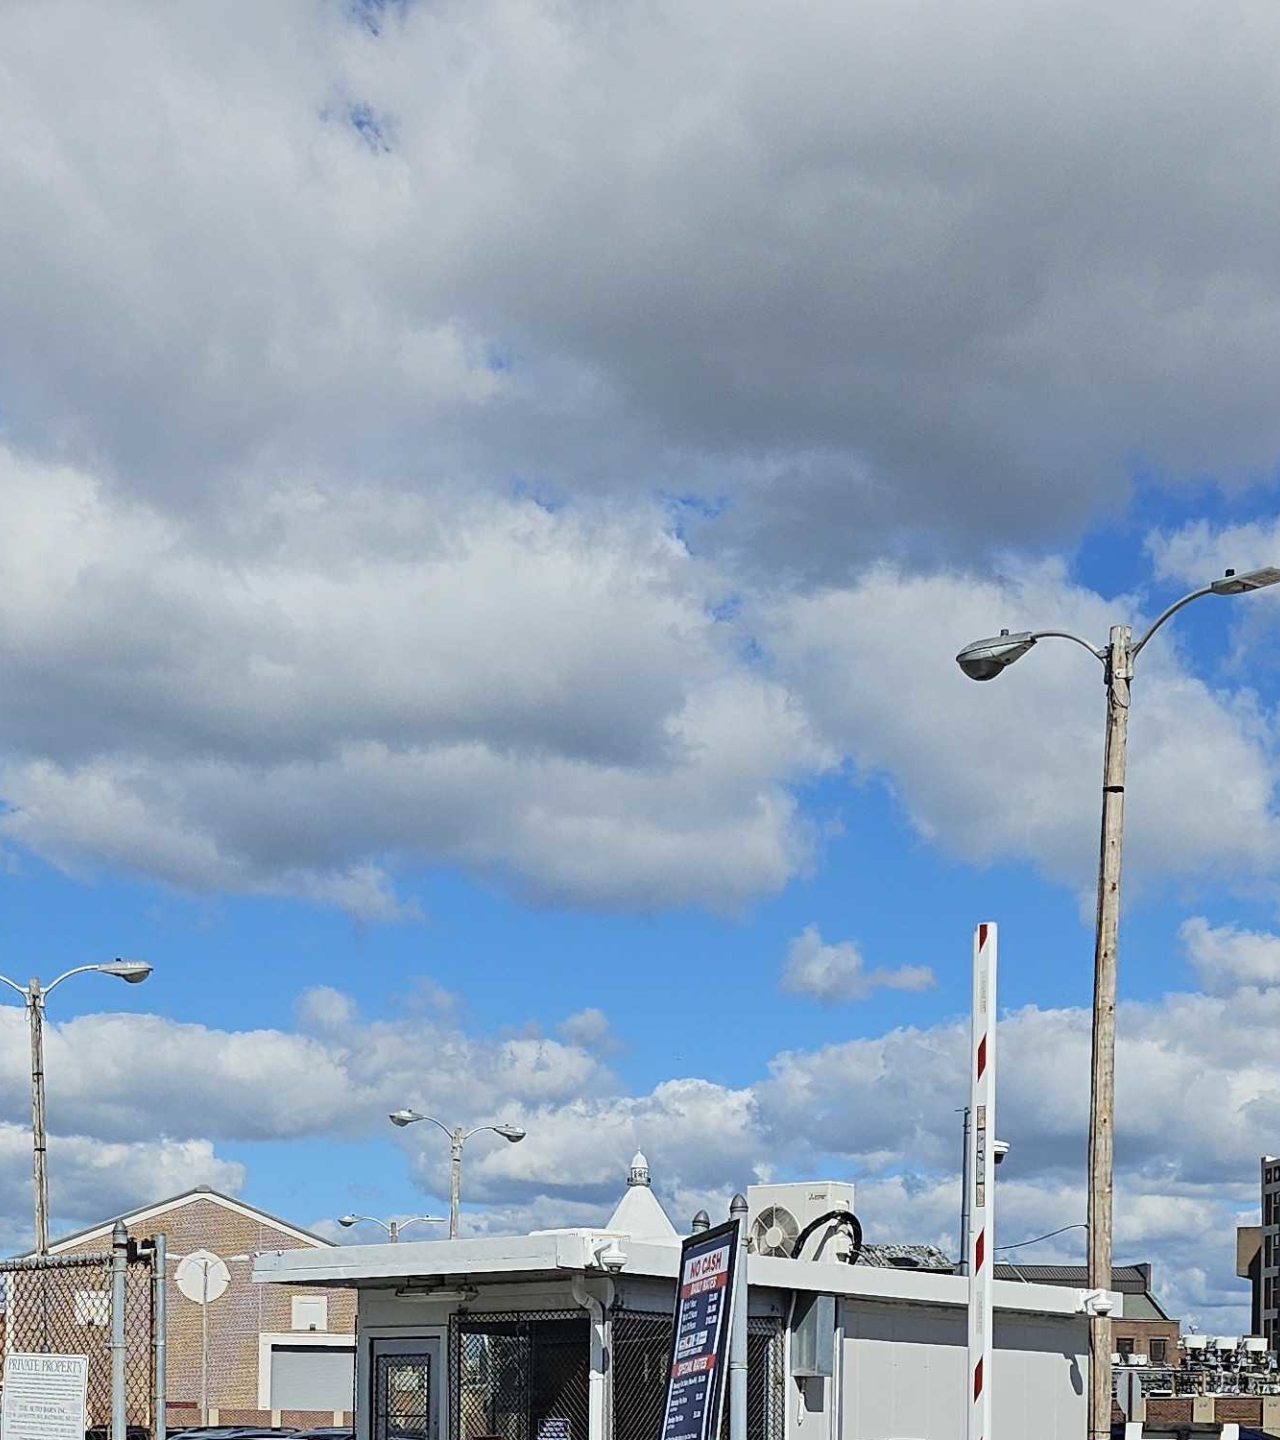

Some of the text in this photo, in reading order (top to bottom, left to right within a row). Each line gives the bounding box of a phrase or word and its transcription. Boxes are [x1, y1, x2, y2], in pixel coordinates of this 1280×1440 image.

[689, 1252, 723, 1279] NO CASH
[8, 1359, 83, 1374] PRIVATE PROPERTY
